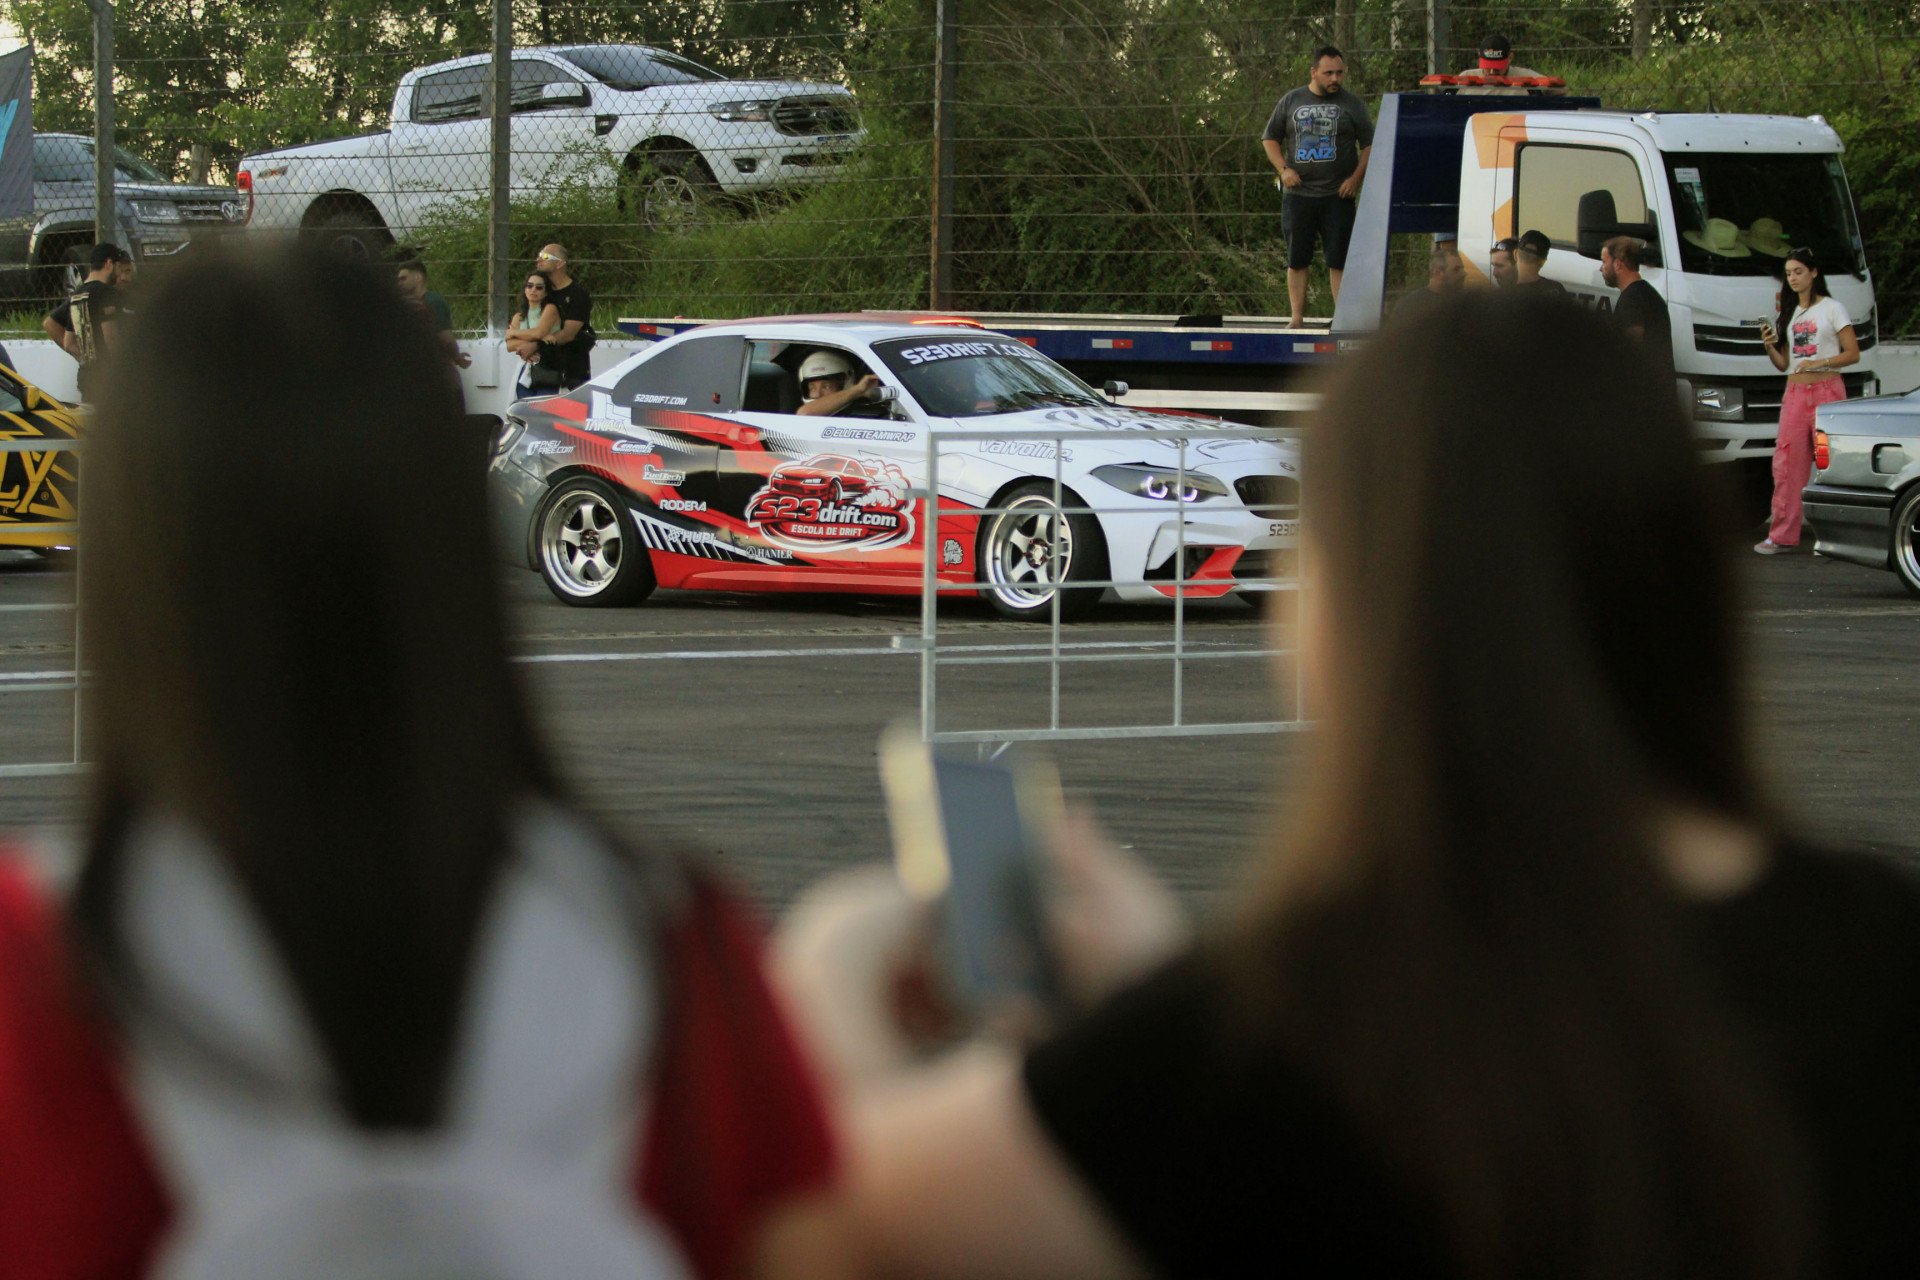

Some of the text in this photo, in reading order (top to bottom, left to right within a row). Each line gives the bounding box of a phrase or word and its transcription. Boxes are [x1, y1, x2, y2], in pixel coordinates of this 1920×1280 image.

[634, 393, 688, 406] S23DRIFT.COM
[659, 499, 707, 512] RODERA
[791, 524, 863, 537] ESCOLA DE DRIFT
[757, 547, 794, 559] HANIER
